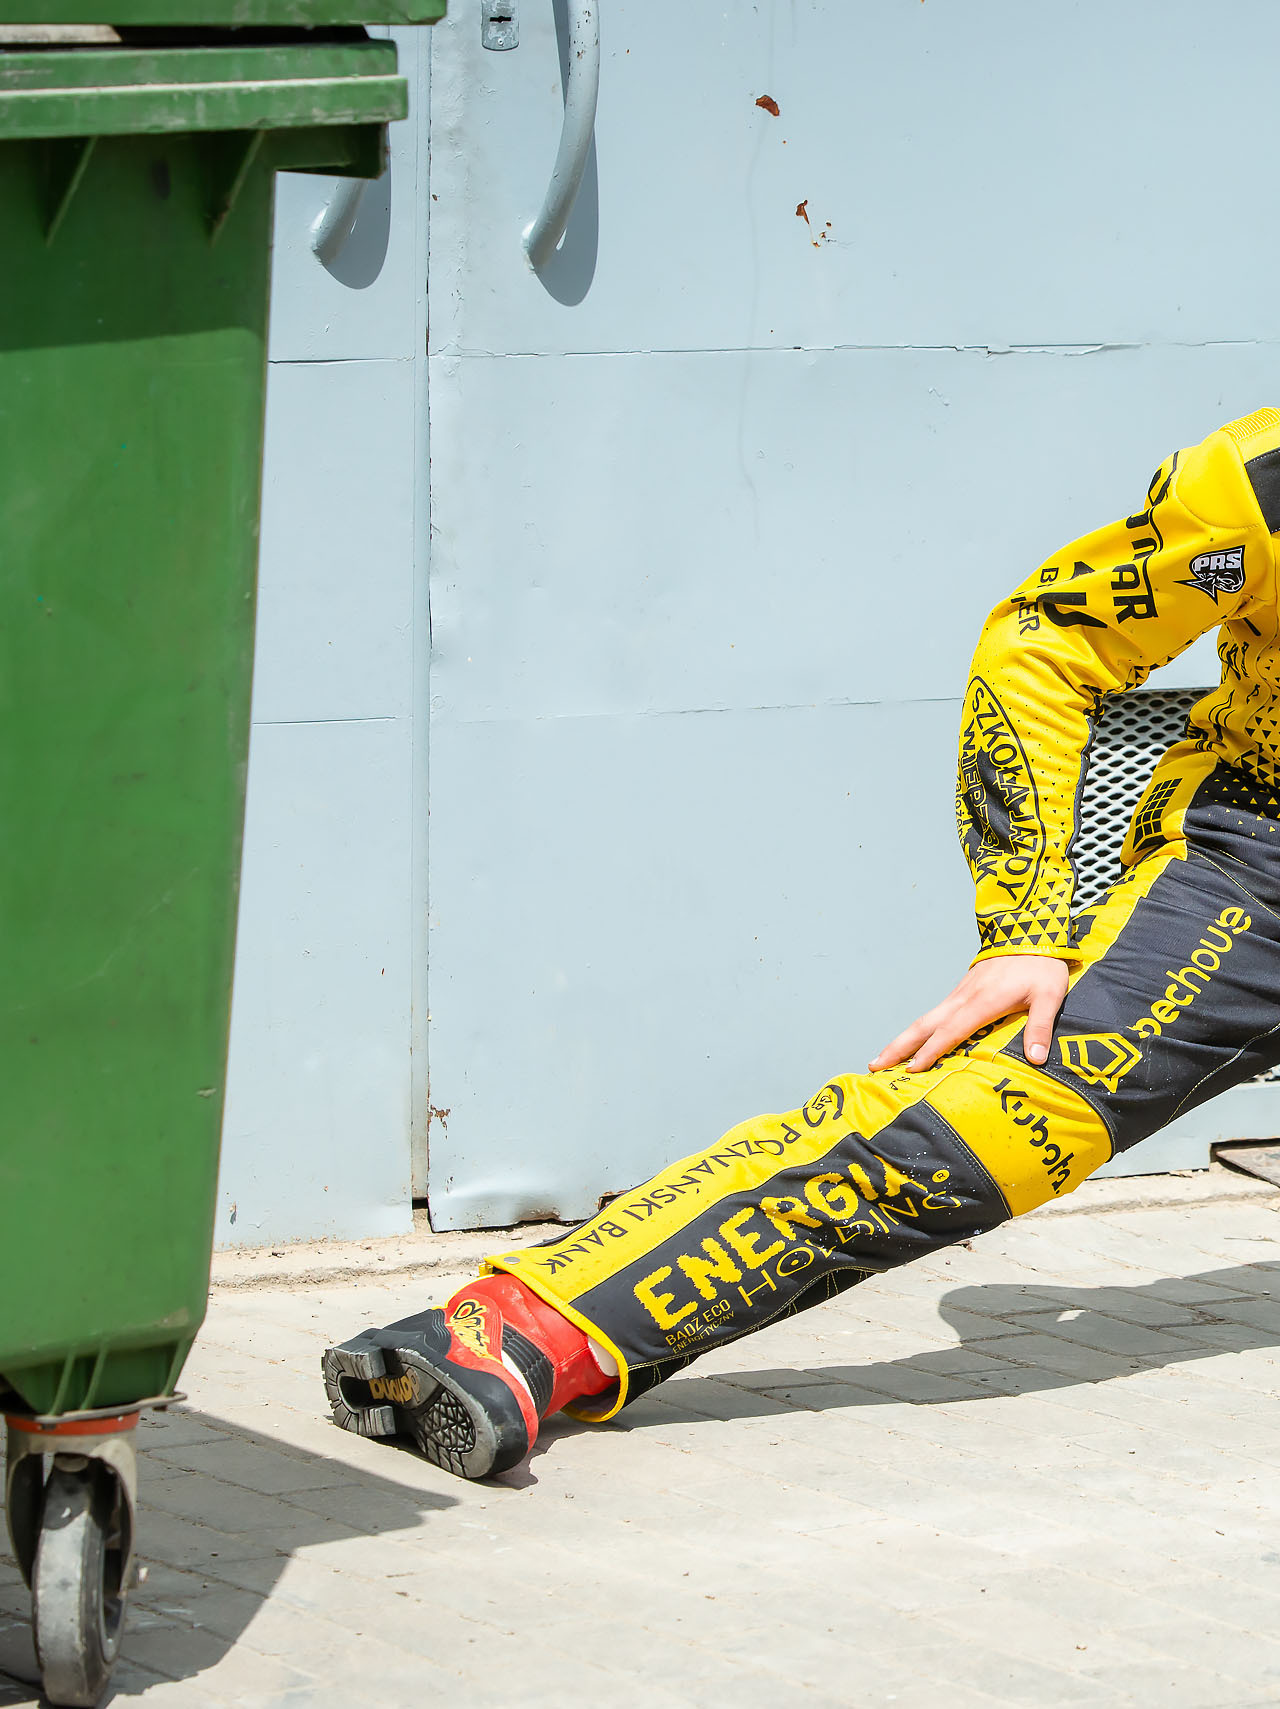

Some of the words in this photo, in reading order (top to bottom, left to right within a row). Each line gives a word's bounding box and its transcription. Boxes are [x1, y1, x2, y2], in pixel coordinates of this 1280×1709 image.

[1193, 552, 1242, 573] PRS
[971, 687, 1030, 806] SZKOŁA
[622, 1122, 802, 1223] POZNAŃSKI
[536, 1219, 629, 1275] BANK
[702, 1299, 731, 1323] ECO
